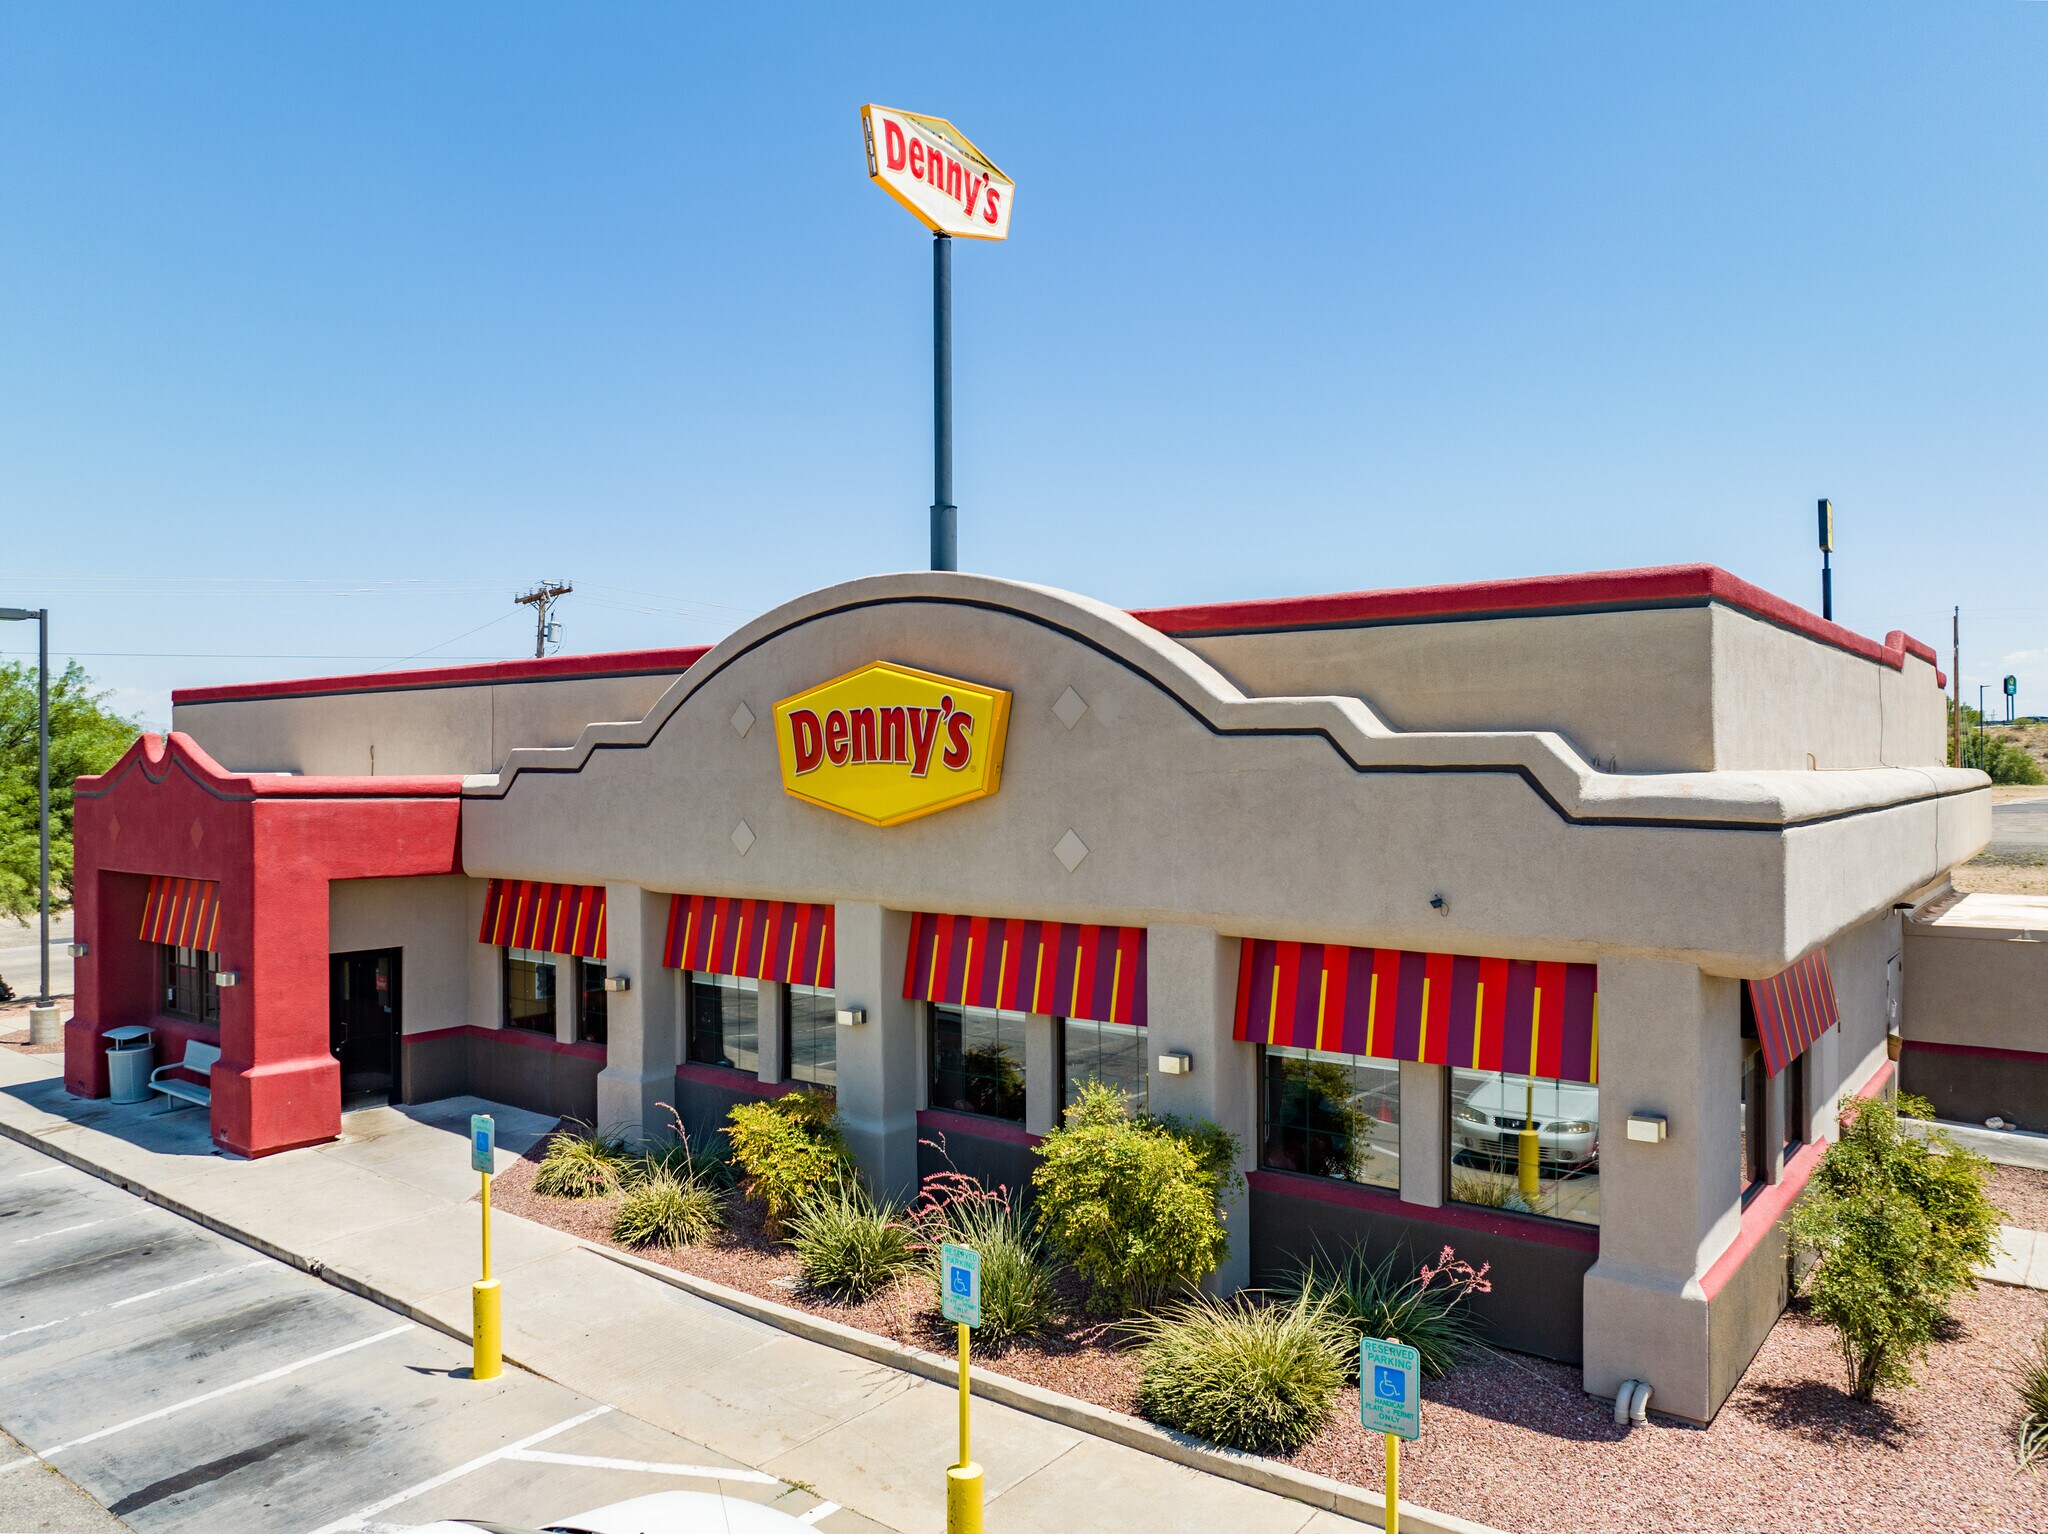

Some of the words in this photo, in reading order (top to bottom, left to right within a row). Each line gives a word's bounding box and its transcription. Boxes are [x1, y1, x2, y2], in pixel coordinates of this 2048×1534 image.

[883, 118, 1000, 225] Denny's
[787, 694, 974, 776] Denny's
[1365, 1342, 1414, 1360] RESERVED
[1367, 1352, 1412, 1371] PARKING
[1365, 1402, 1384, 1412] PLATE
[1393, 1409, 1414, 1419] PERMIT
[1374, 1398, 1405, 1410] HANDICAP
[1379, 1412, 1400, 1423] ONLY
